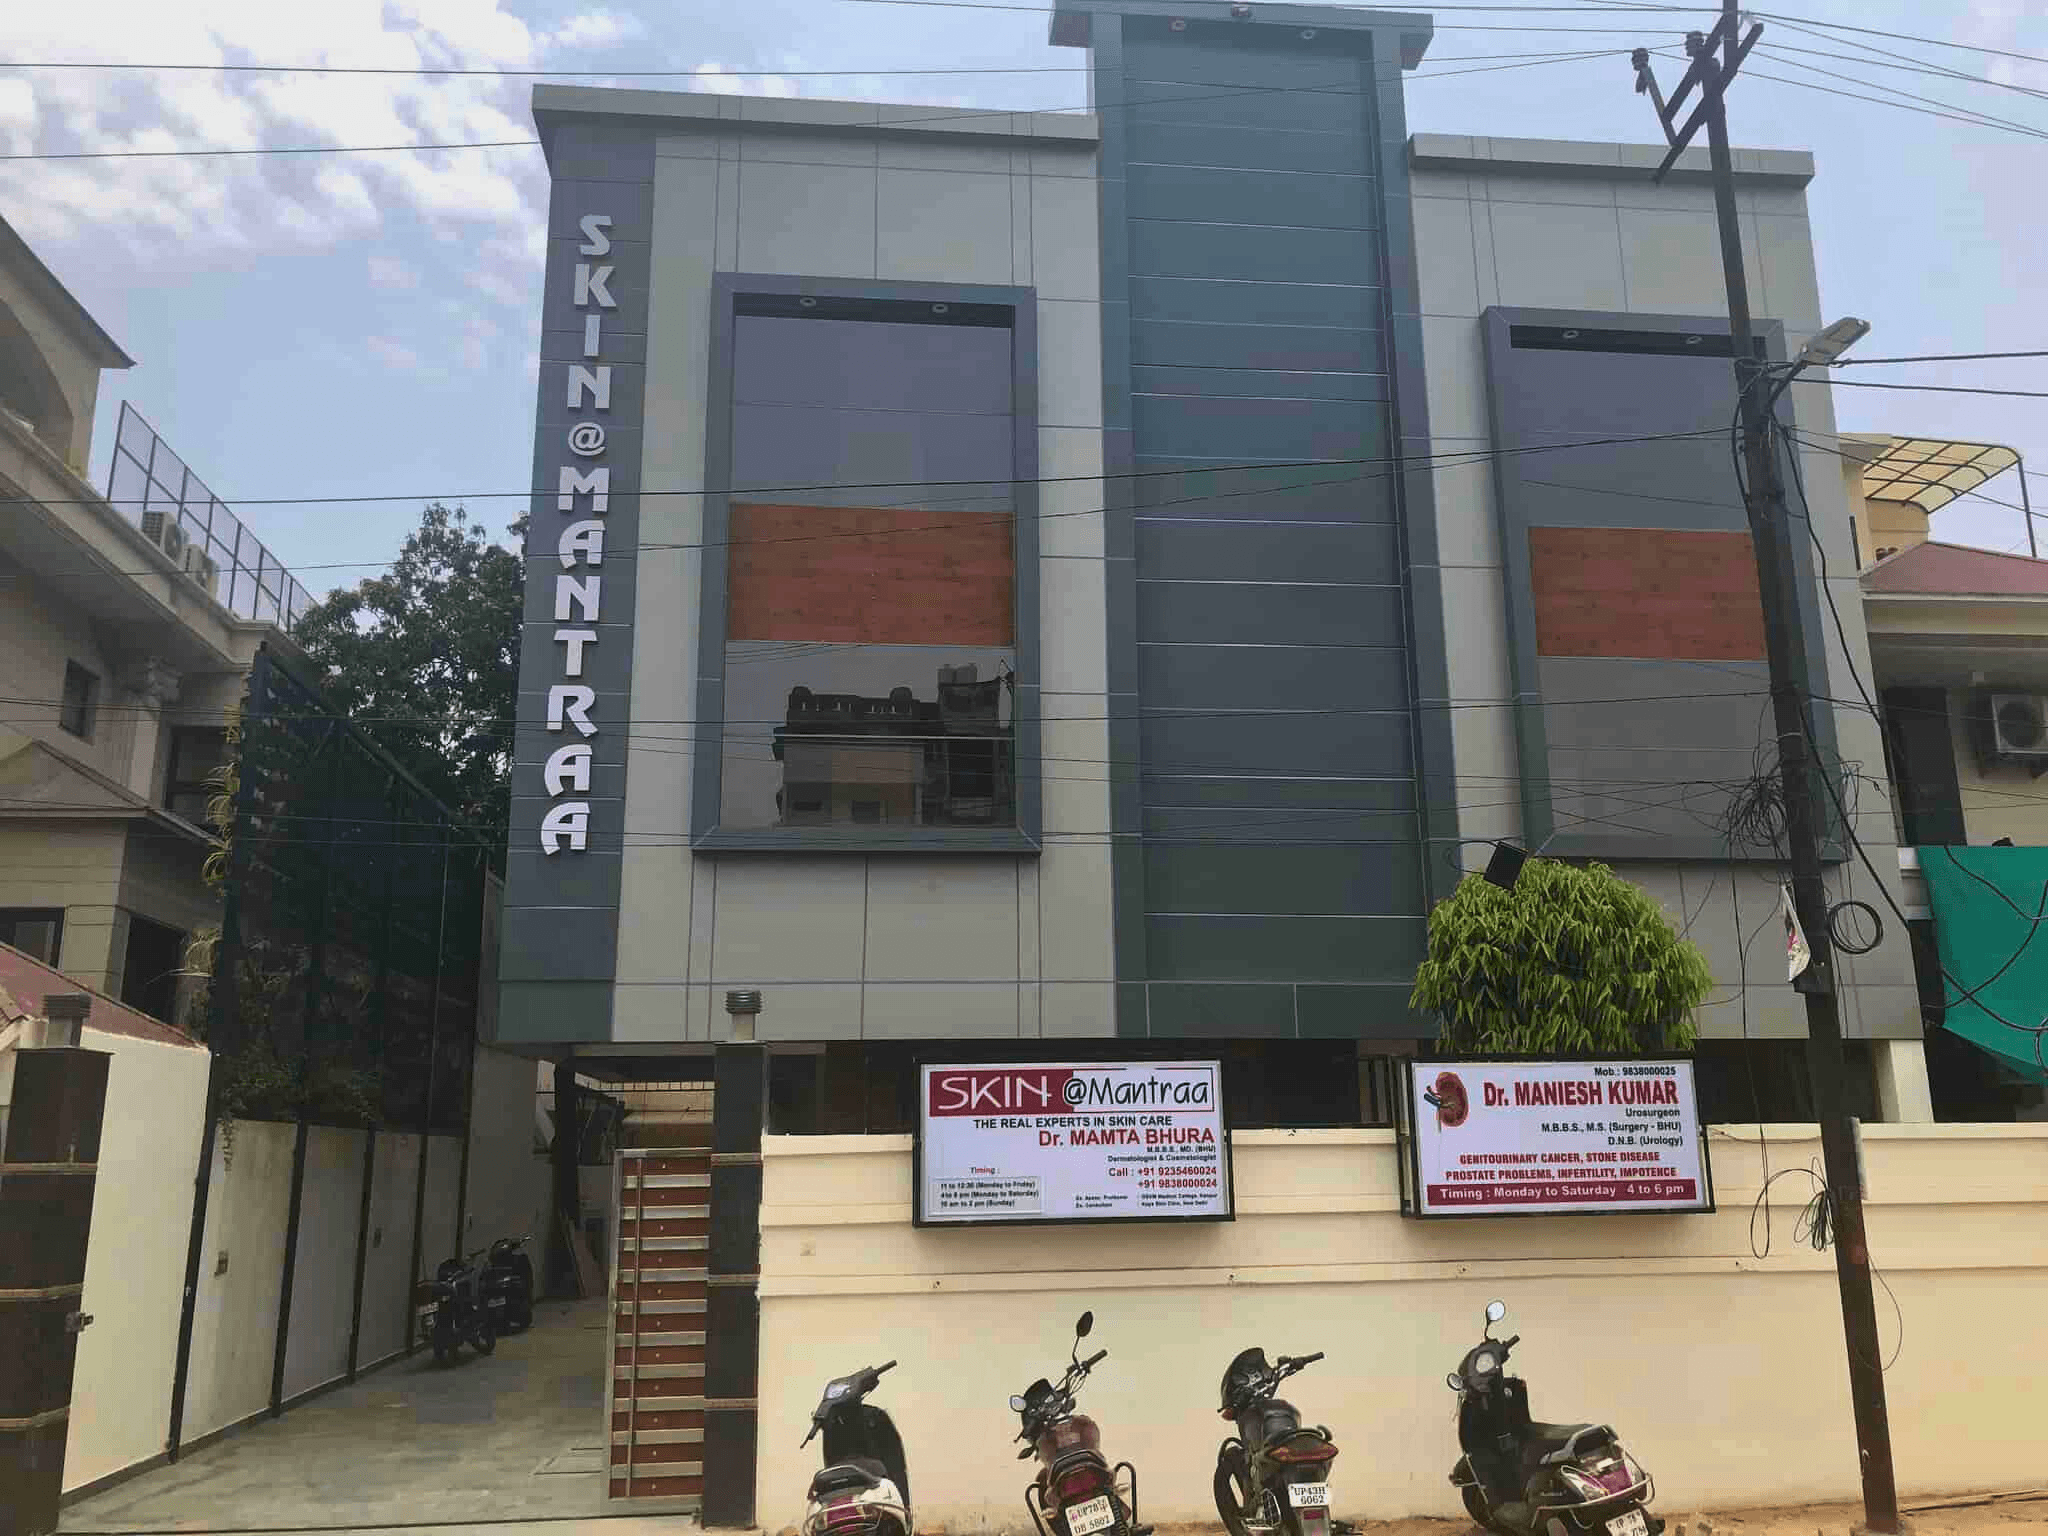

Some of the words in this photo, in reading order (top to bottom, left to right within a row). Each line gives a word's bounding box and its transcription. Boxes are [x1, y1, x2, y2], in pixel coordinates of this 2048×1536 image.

[1622, 1066, 1676, 1076] 9838000025
[937, 1075, 1052, 1110] SKIN
[1063, 1076, 1209, 1105] @Mantraa
[1484, 1081, 1509, 1106] Dr.
[1514, 1081, 1603, 1106] MANIESH
[1608, 1080, 1680, 1105] KUMAR
[1625, 1107, 1680, 1118] Urosurgeon
[973, 1118, 997, 1129] THE
[1000, 1118, 1032, 1129] REAL
[1035, 1117, 1090, 1128] EXPERTS
[1093, 1116, 1105, 1127] IN
[1108, 1116, 1136, 1126] SKIN
[1139, 1115, 1173, 1126] CARE
[1609, 1121, 1649, 1133] (Surgery
[1656, 1121, 1682, 1133] BHU)
[1038, 1129, 1064, 1147] Dr.
[1070, 1128, 1140, 1146] MAMTA
[1145, 1127, 1216, 1145] BHURA
[1640, 1135, 1684, 1149] (Urology)
[1459, 1153, 1538, 1165] GENITOURINARY
[1586, 1152, 1618, 1162] STONE
[1620, 1151, 1660, 1161] DISEASE
[1108, 1167, 1128, 1177] Call
[1138, 1167, 1154, 1176] +91
[1445, 1170, 1496, 1181] PROSTATE
[1619, 1167, 1679, 1177] IMPOTENCE
[1138, 1179, 1155, 1189] +91
[1158, 1178, 1217, 1188] 9838000024
[1439, 1188, 1483, 1201] Timing
[1493, 1187, 1542, 1200] Monday
[1545, 1187, 1558, 1197] to
[1561, 1186, 1616, 1199] Saturday
[1626, 1185, 1635, 1195] 4
[1638, 1185, 1651, 1194] to
[1654, 1185, 1661, 1194] 6
[1665, 1186, 1685, 1196] pm
